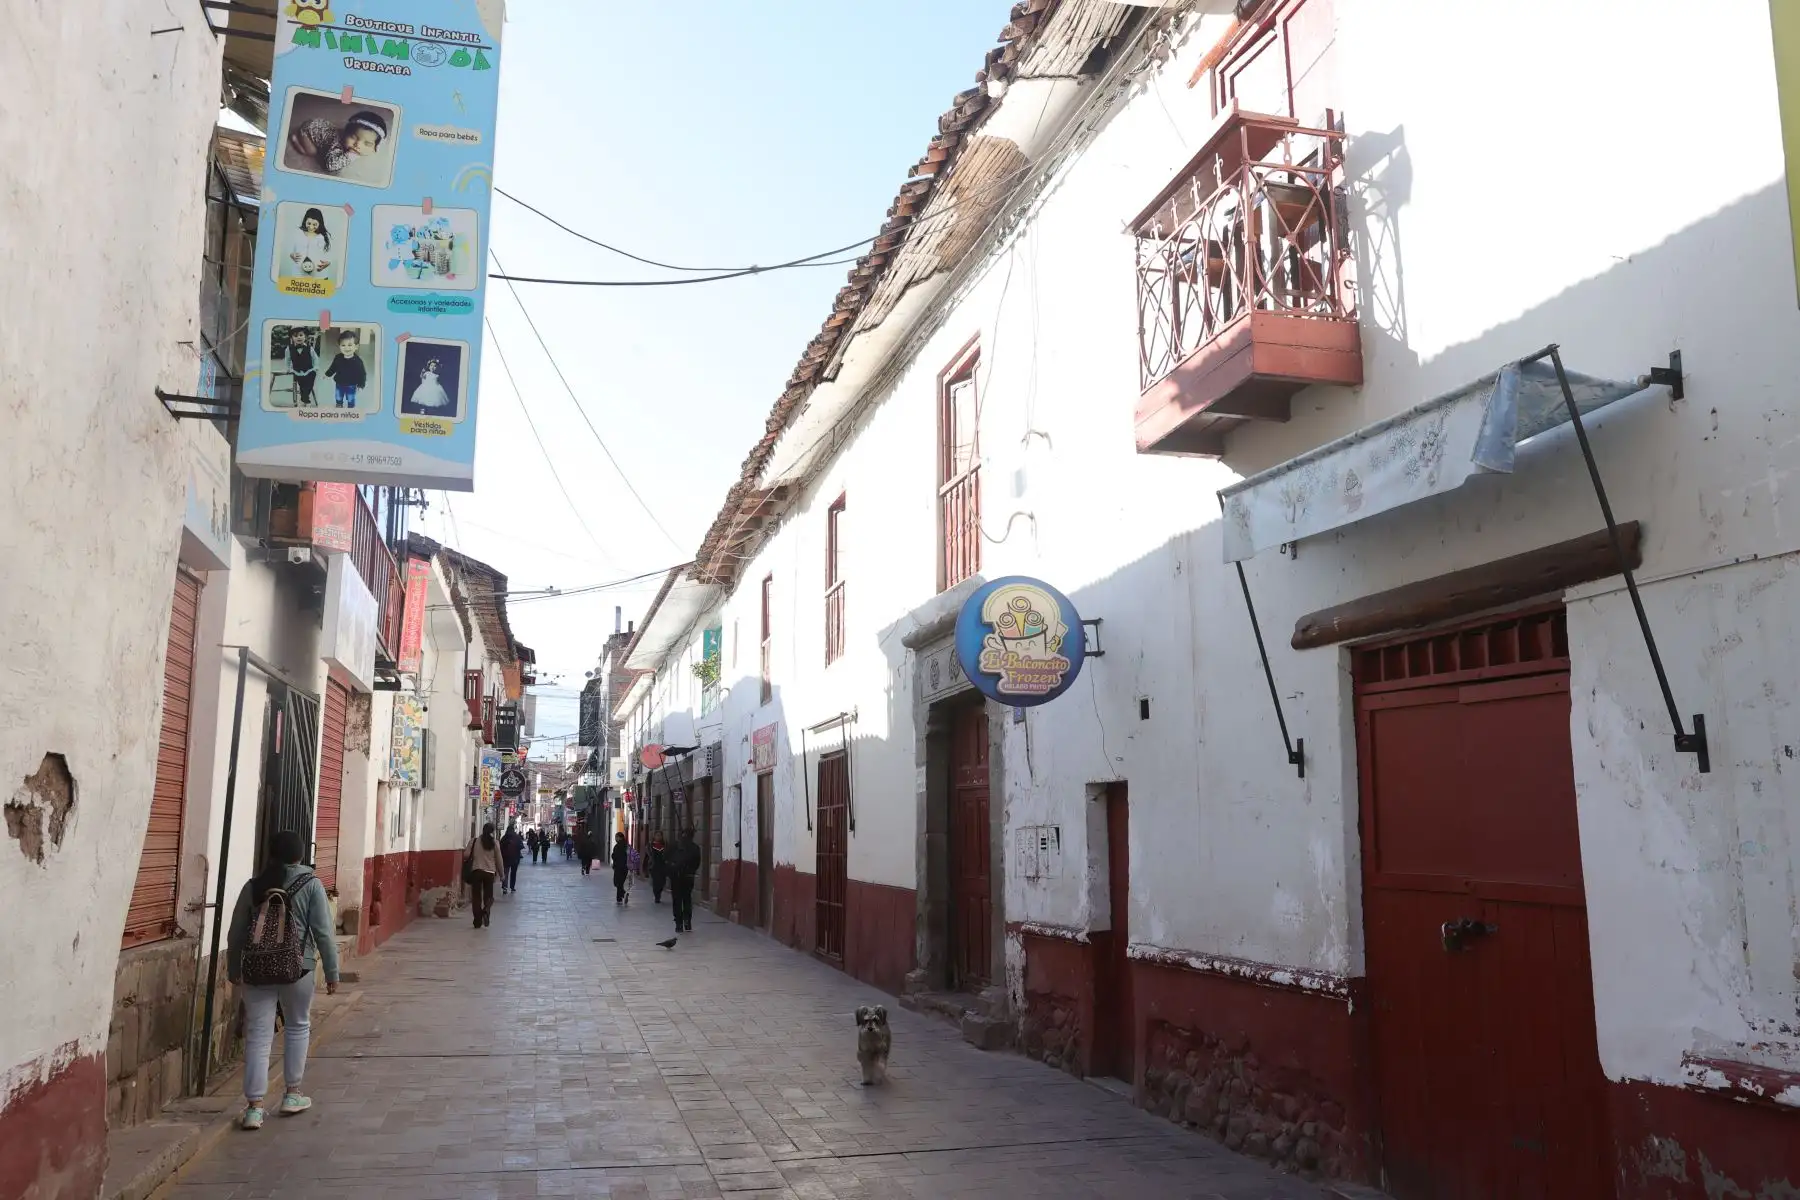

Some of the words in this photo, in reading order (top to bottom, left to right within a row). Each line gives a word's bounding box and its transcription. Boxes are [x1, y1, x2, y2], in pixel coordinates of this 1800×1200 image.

[345, 14, 414, 35] BOUTIQUE
[421, 25, 481, 43] INFANTIL
[344, 57, 412, 76] URUBAMBA
[420, 128, 438, 138] Ropa
[438, 131, 456, 139] para
[285, 285, 327, 295] maternidad
[290, 279, 310, 289] Ropa
[311, 281, 321, 290] de
[298, 410, 319, 420] Ropa
[320, 411, 338, 420] para
[341, 410, 360, 419] niños
[410, 426, 428, 435] para
[1003, 652, 1067, 669] Balconcito
[1008, 671, 1057, 684] Frozen
